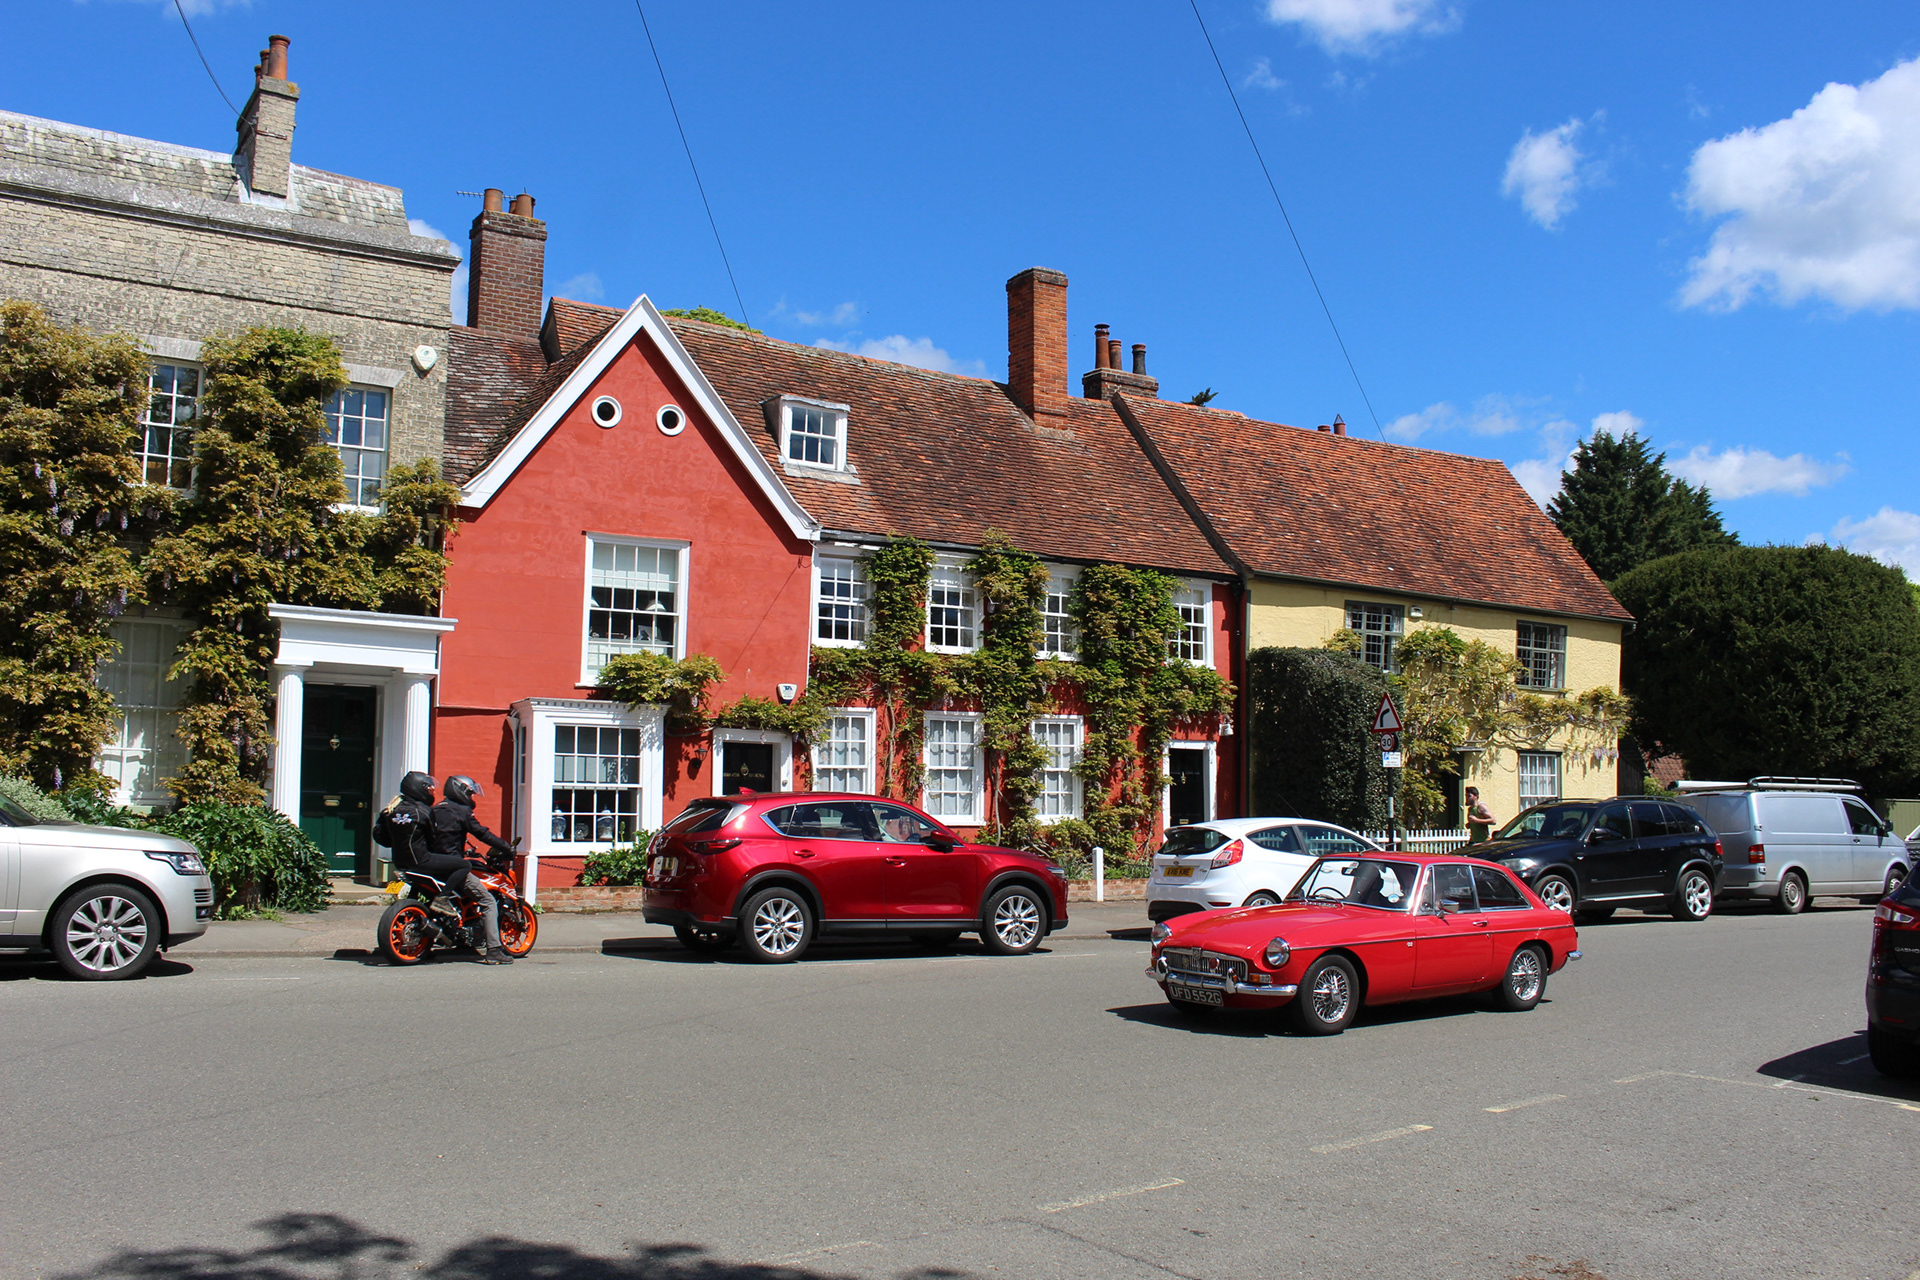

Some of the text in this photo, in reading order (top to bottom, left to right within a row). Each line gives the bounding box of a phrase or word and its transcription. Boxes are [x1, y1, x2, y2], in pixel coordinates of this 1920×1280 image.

[1382, 738, 1392, 747] 30
[1171, 985, 1221, 1004] UFD 552G
